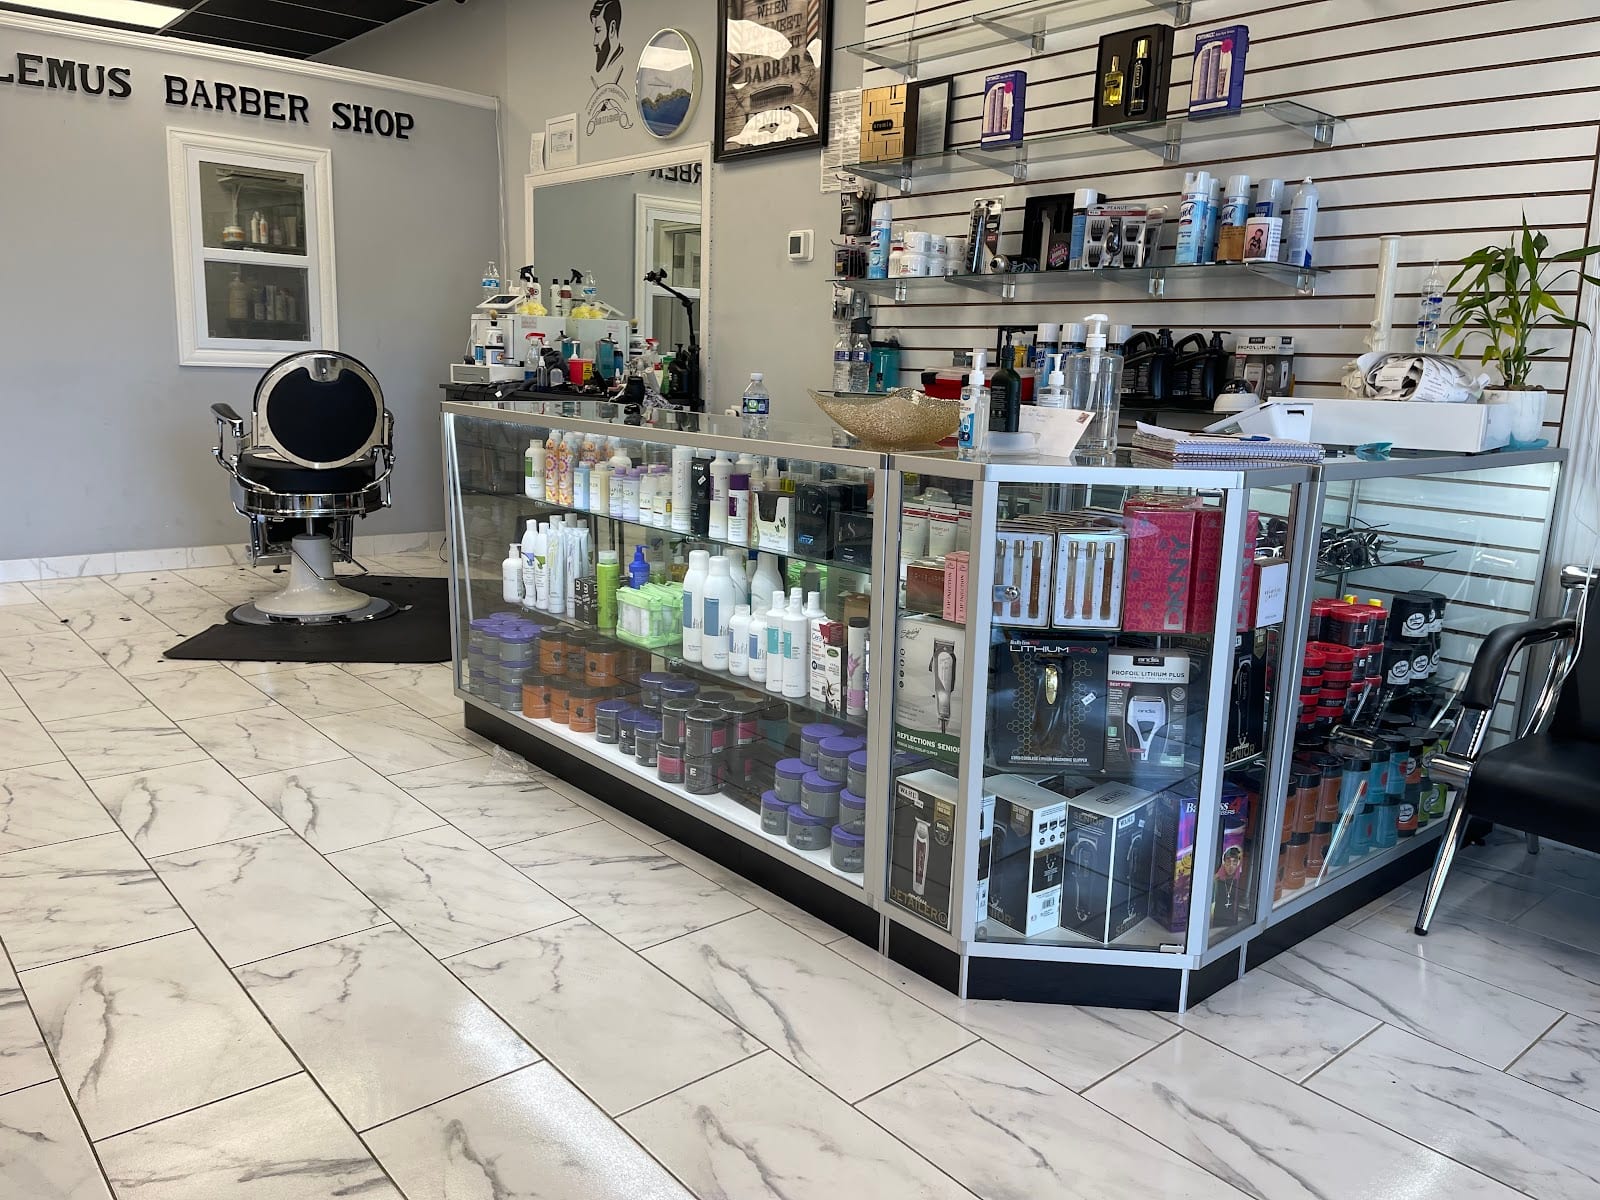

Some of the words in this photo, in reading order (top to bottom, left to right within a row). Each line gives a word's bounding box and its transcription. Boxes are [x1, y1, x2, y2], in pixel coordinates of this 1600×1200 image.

[757, 0, 788, 18] WHEN
[744, 54, 801, 85] BARBER
[164, 74, 310, 123] BARBER
[331, 102, 415, 140] SHOP
[1163, 535, 1190, 631] DKNY
[896, 731, 936, 748] REFLECTIONS
[1224, 743, 1256, 763] SENIOR
[900, 785, 918, 800] WAHL
[1073, 811, 1105, 828] SENIOR
[890, 886, 938, 921] DETAILER
